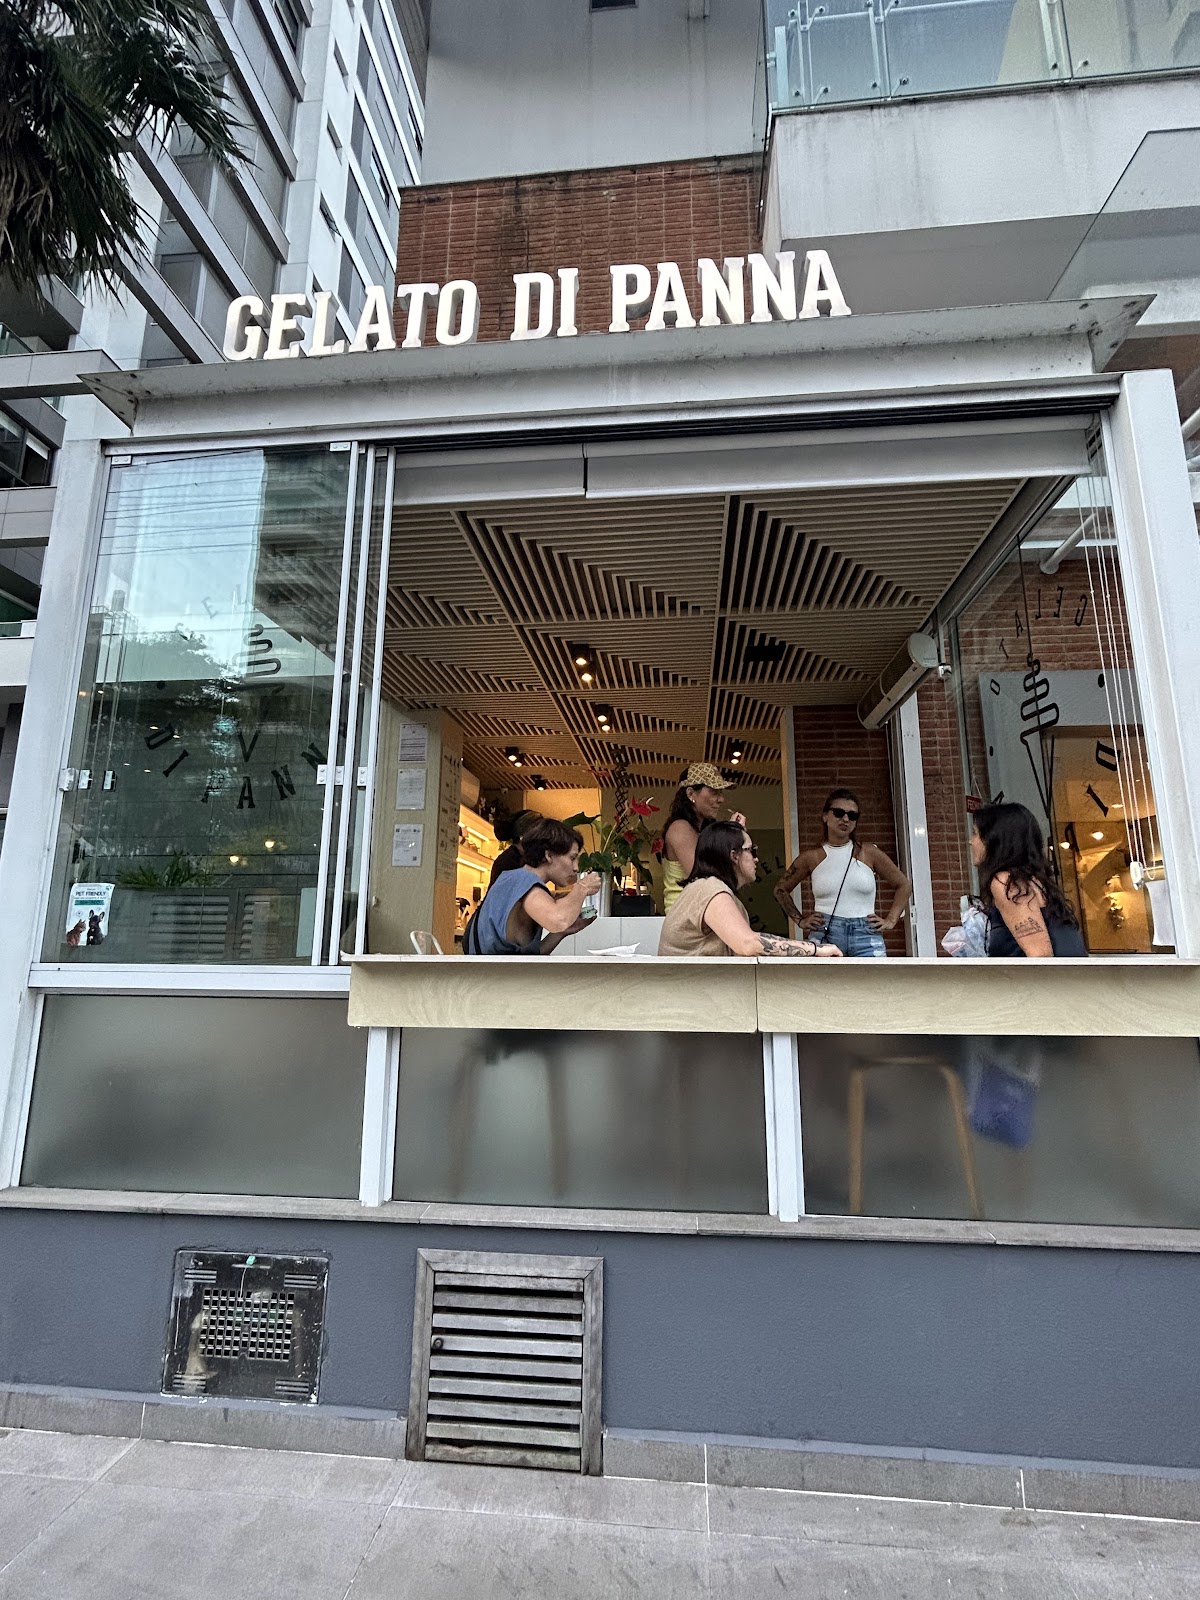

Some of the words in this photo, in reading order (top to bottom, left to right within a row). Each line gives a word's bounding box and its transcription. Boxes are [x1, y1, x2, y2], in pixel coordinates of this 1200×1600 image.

[222, 279, 480, 361] GELATO
[510, 268, 579, 341] DI
[609, 249, 852, 332] PANNA
